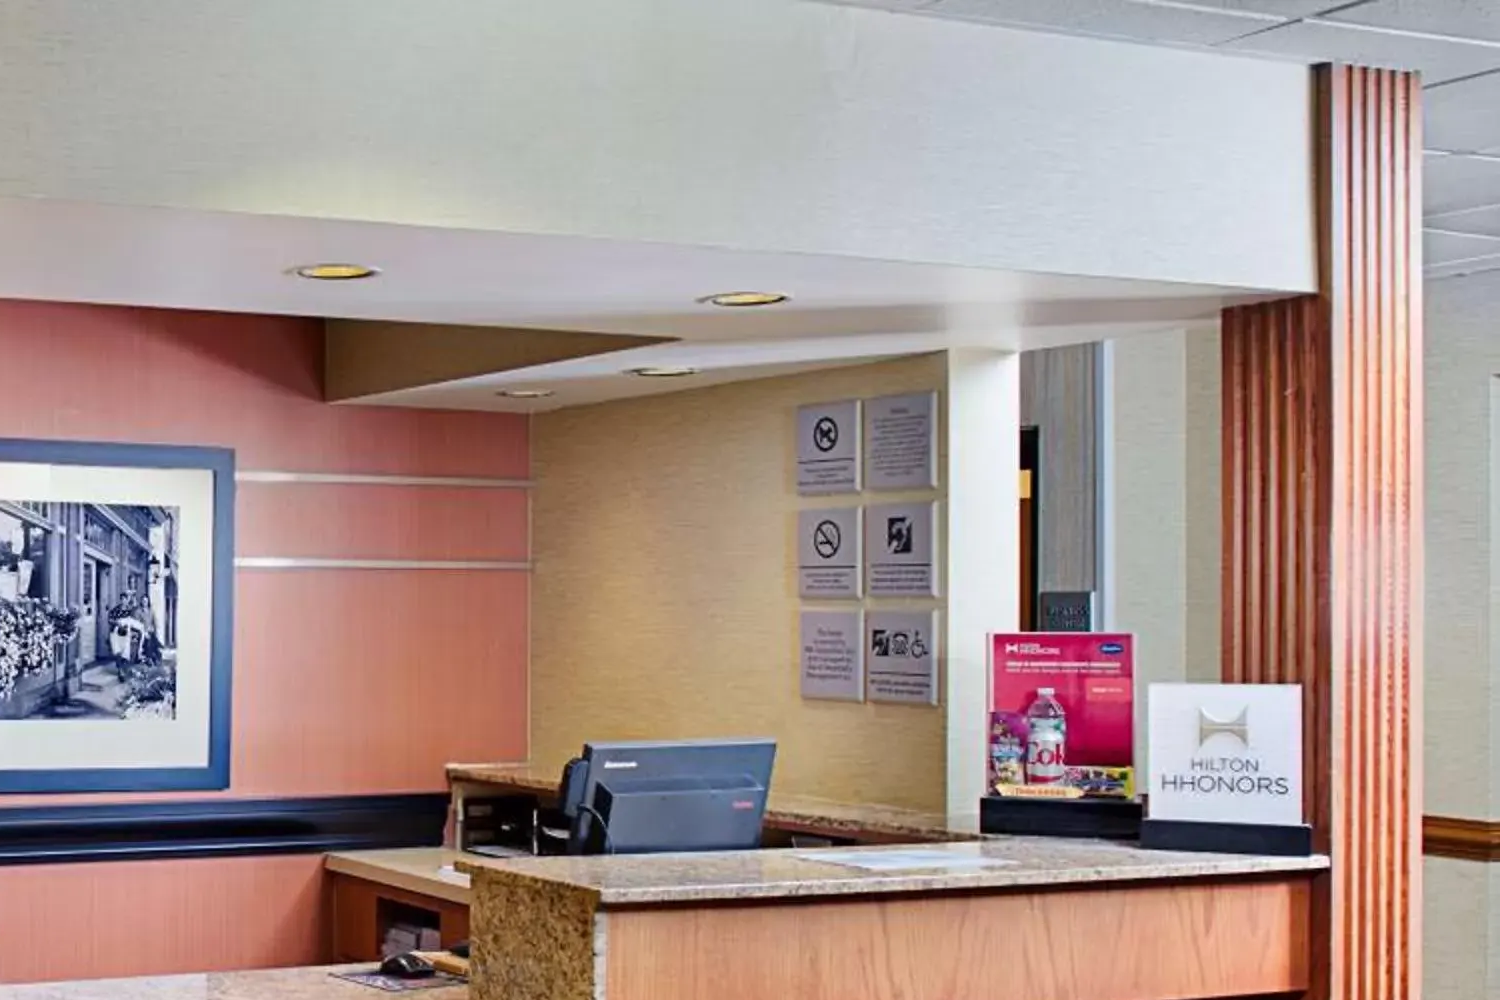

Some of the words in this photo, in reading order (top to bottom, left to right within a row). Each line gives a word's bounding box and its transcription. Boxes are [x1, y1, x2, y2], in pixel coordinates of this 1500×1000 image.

[1028, 741, 1065, 765] Cok
[1190, 757, 1260, 773] HILTON
[1160, 774, 1290, 795] HHONORS
